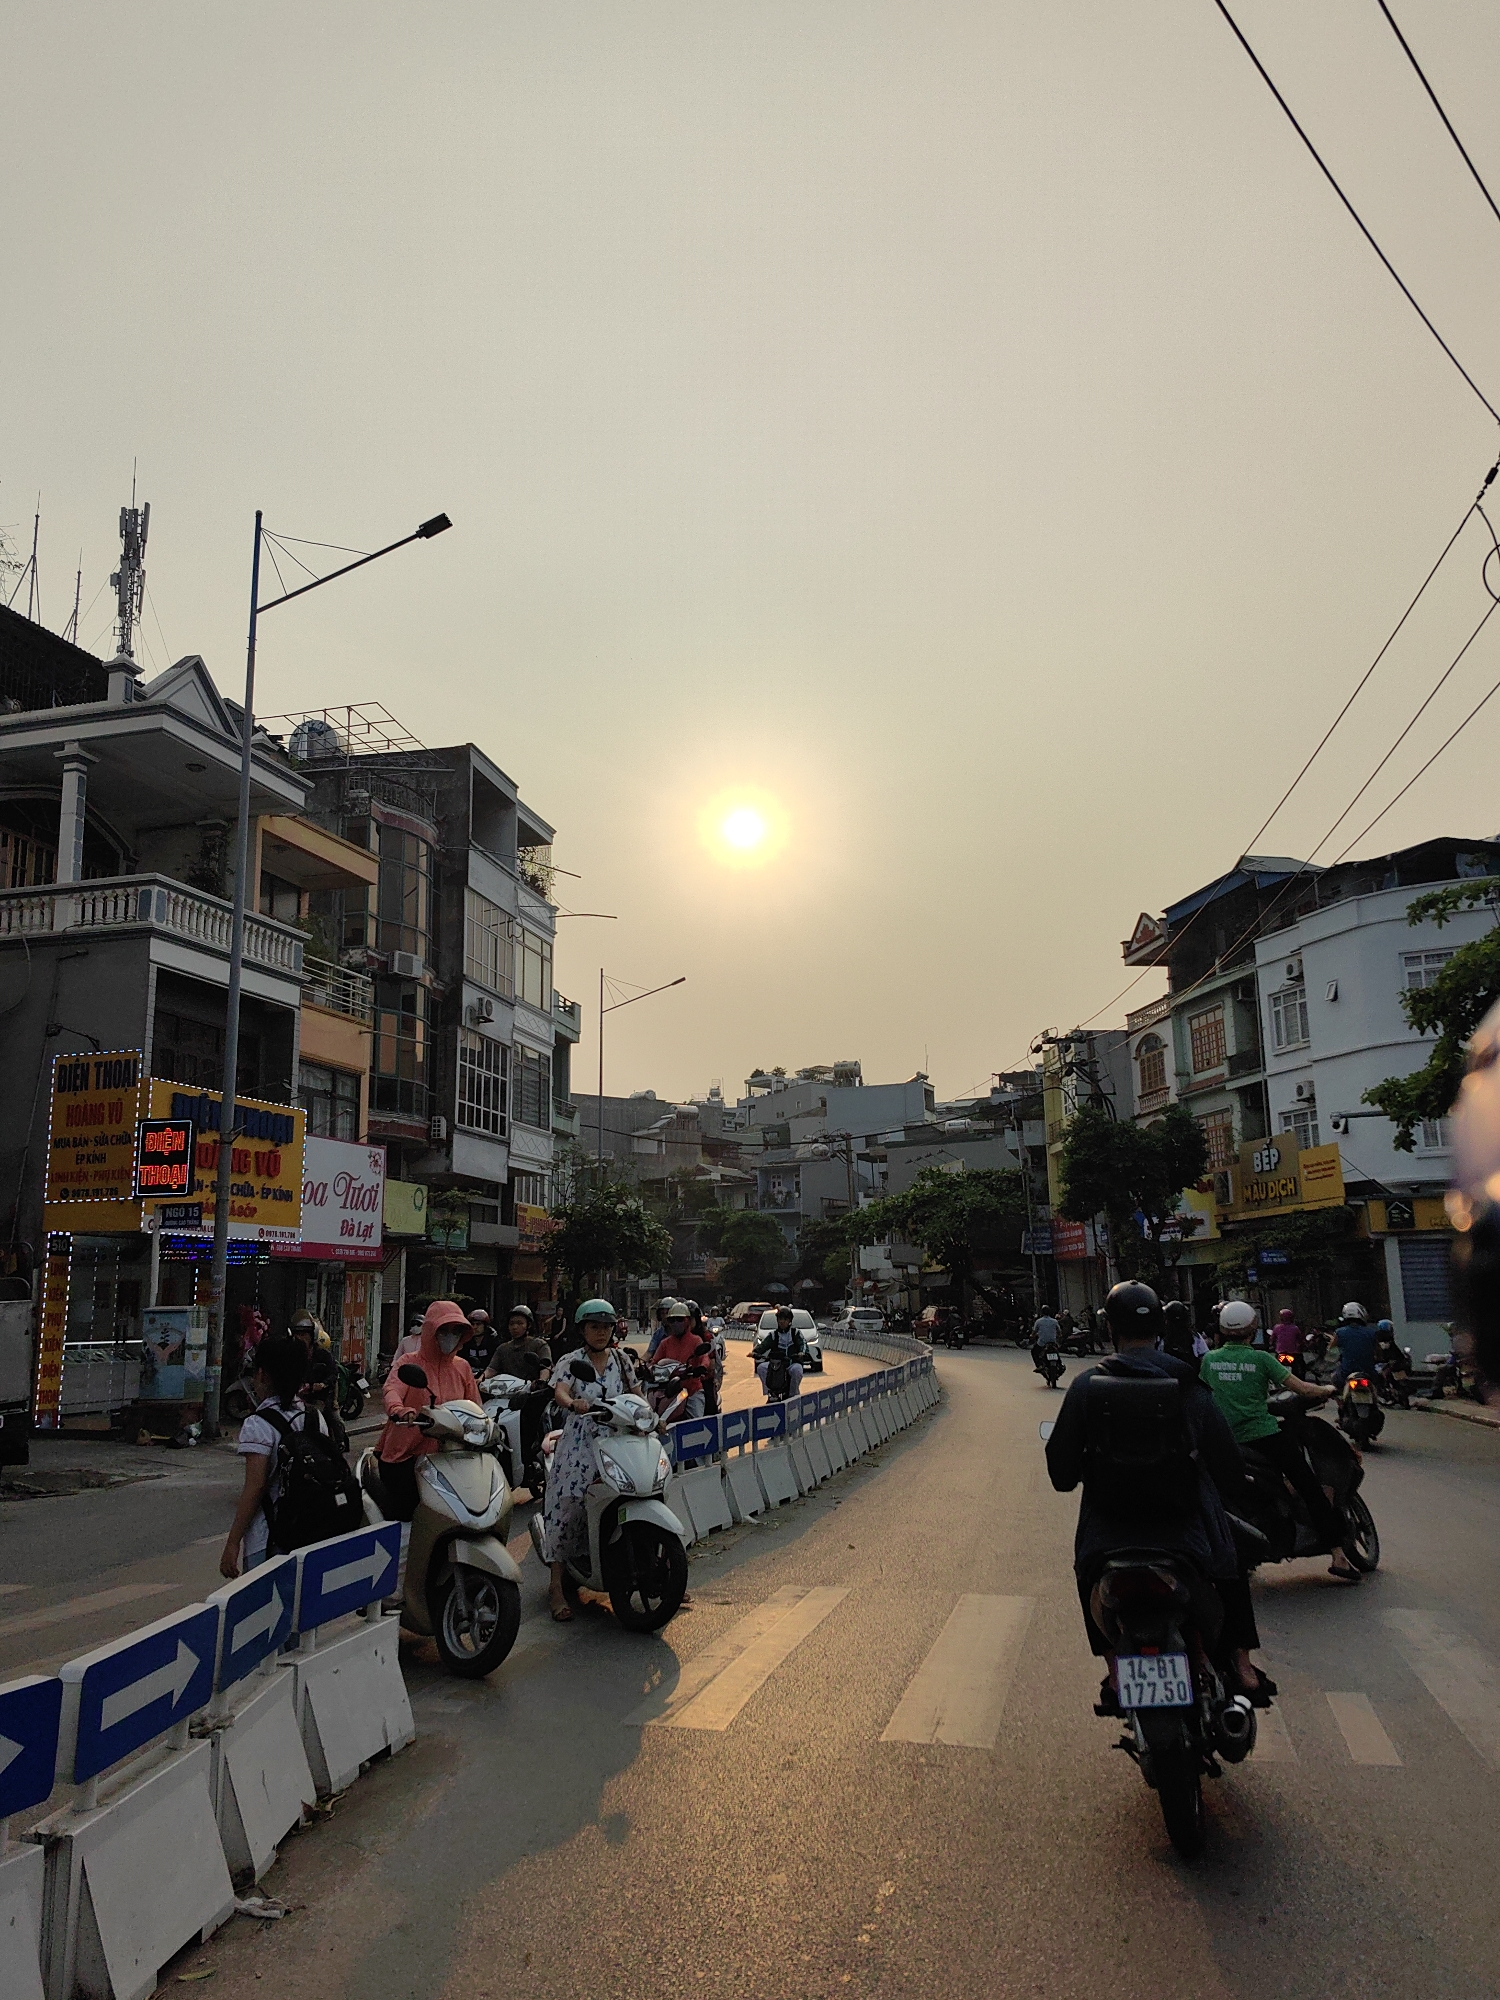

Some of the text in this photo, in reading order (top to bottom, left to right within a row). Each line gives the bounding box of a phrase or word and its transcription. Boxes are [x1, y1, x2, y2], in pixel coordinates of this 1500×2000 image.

[57, 1058, 137, 1096] ĐIỆN THOẠI
[66, 1098, 123, 1127] HOÀNG VŨ
[53, 1130, 132, 1149] MUA BÁN SỬA CHỮA
[145, 1127, 185, 1156] ĐIỆN
[75, 1150, 107, 1165] ÉP KÍNH
[255, 1148, 281, 1179] VŨ
[1253, 1138, 1280, 1174] BẾP
[139, 1164, 187, 1190] THOẠI
[1267, 1176, 1297, 1204] DỊCH
[261, 1183, 272, 1200] ÉP
[272, 1185, 293, 1202] KÍNH
[303, 1171, 379, 1213] oa Tươi
[188, 1206, 200, 1217] 15
[340, 1218, 374, 1243] Đà Lạt
[1218, 1372, 1242, 1381] GREEN
[1124, 1681, 1187, 1705] 177.50
